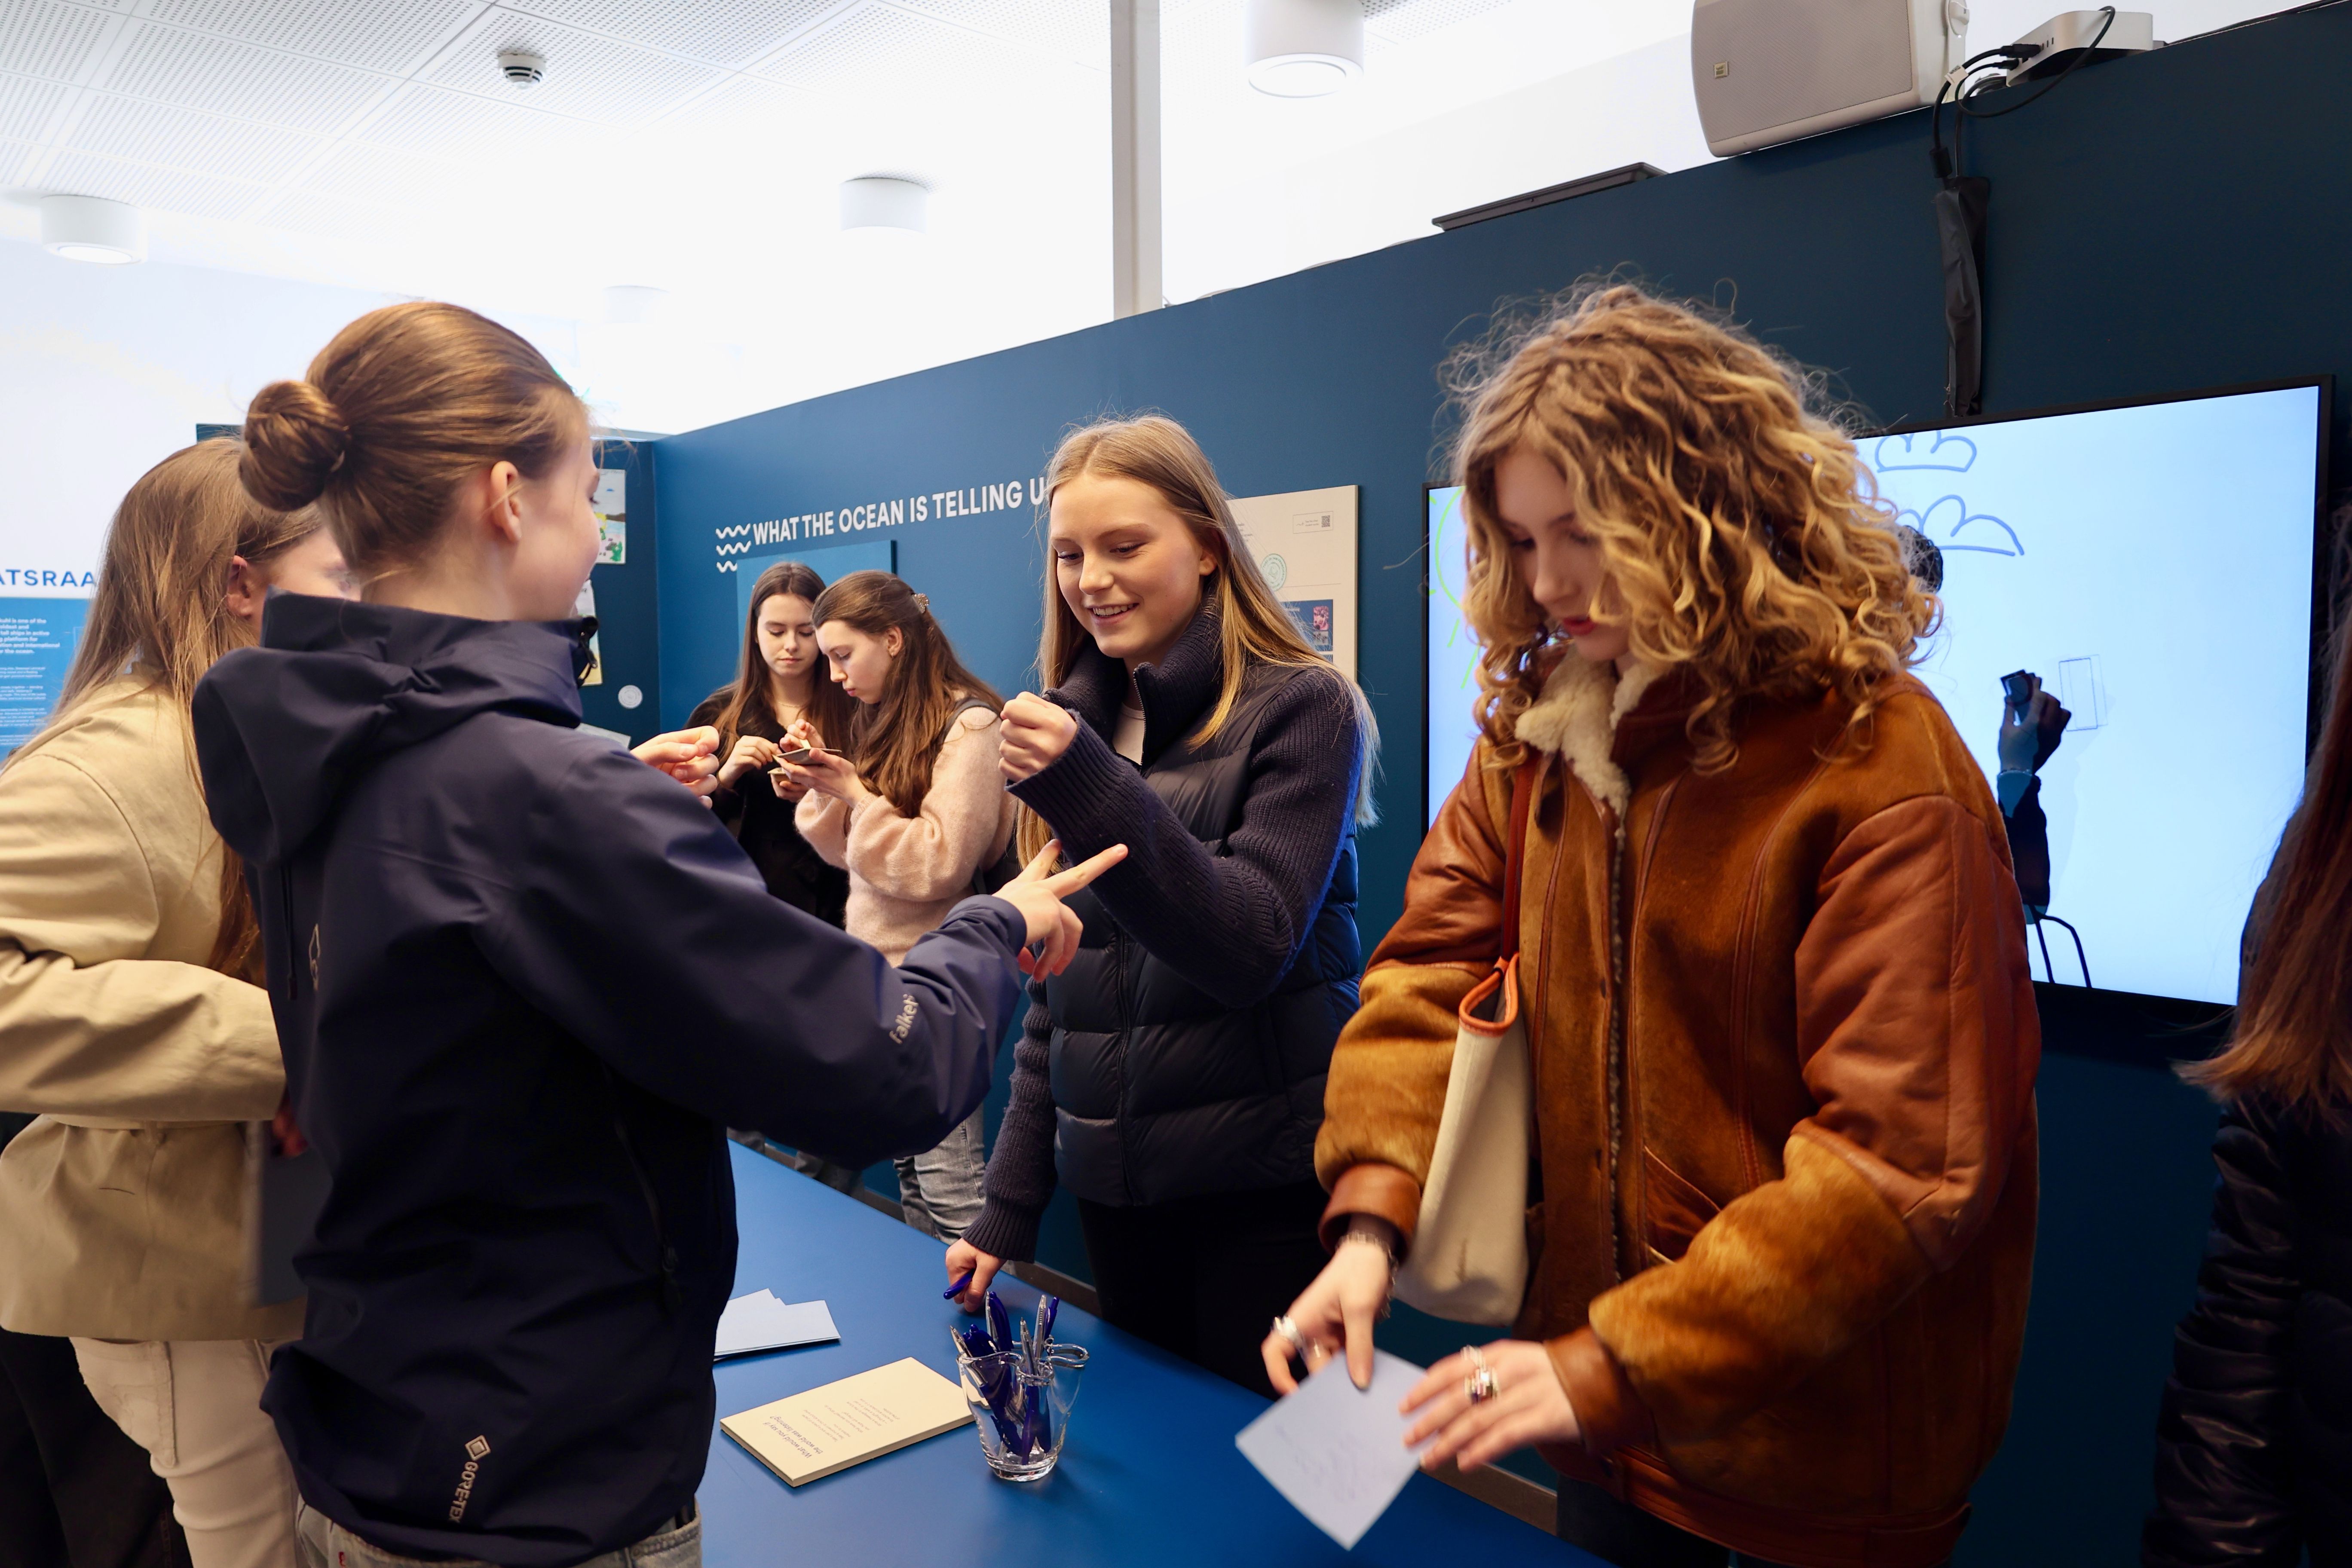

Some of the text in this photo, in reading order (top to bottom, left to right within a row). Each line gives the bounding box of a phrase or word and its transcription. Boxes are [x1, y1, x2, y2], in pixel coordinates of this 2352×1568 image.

[753, 477, 1044, 545] WHAT THE OCEAN IS TELLING U
[0, 569, 96, 587] TSRAA
[769, 1416, 793, 1431] listening?
[783, 1436, 799, 1447] would
[799, 1437, 815, 1447] world
[797, 1447, 812, 1458] What
